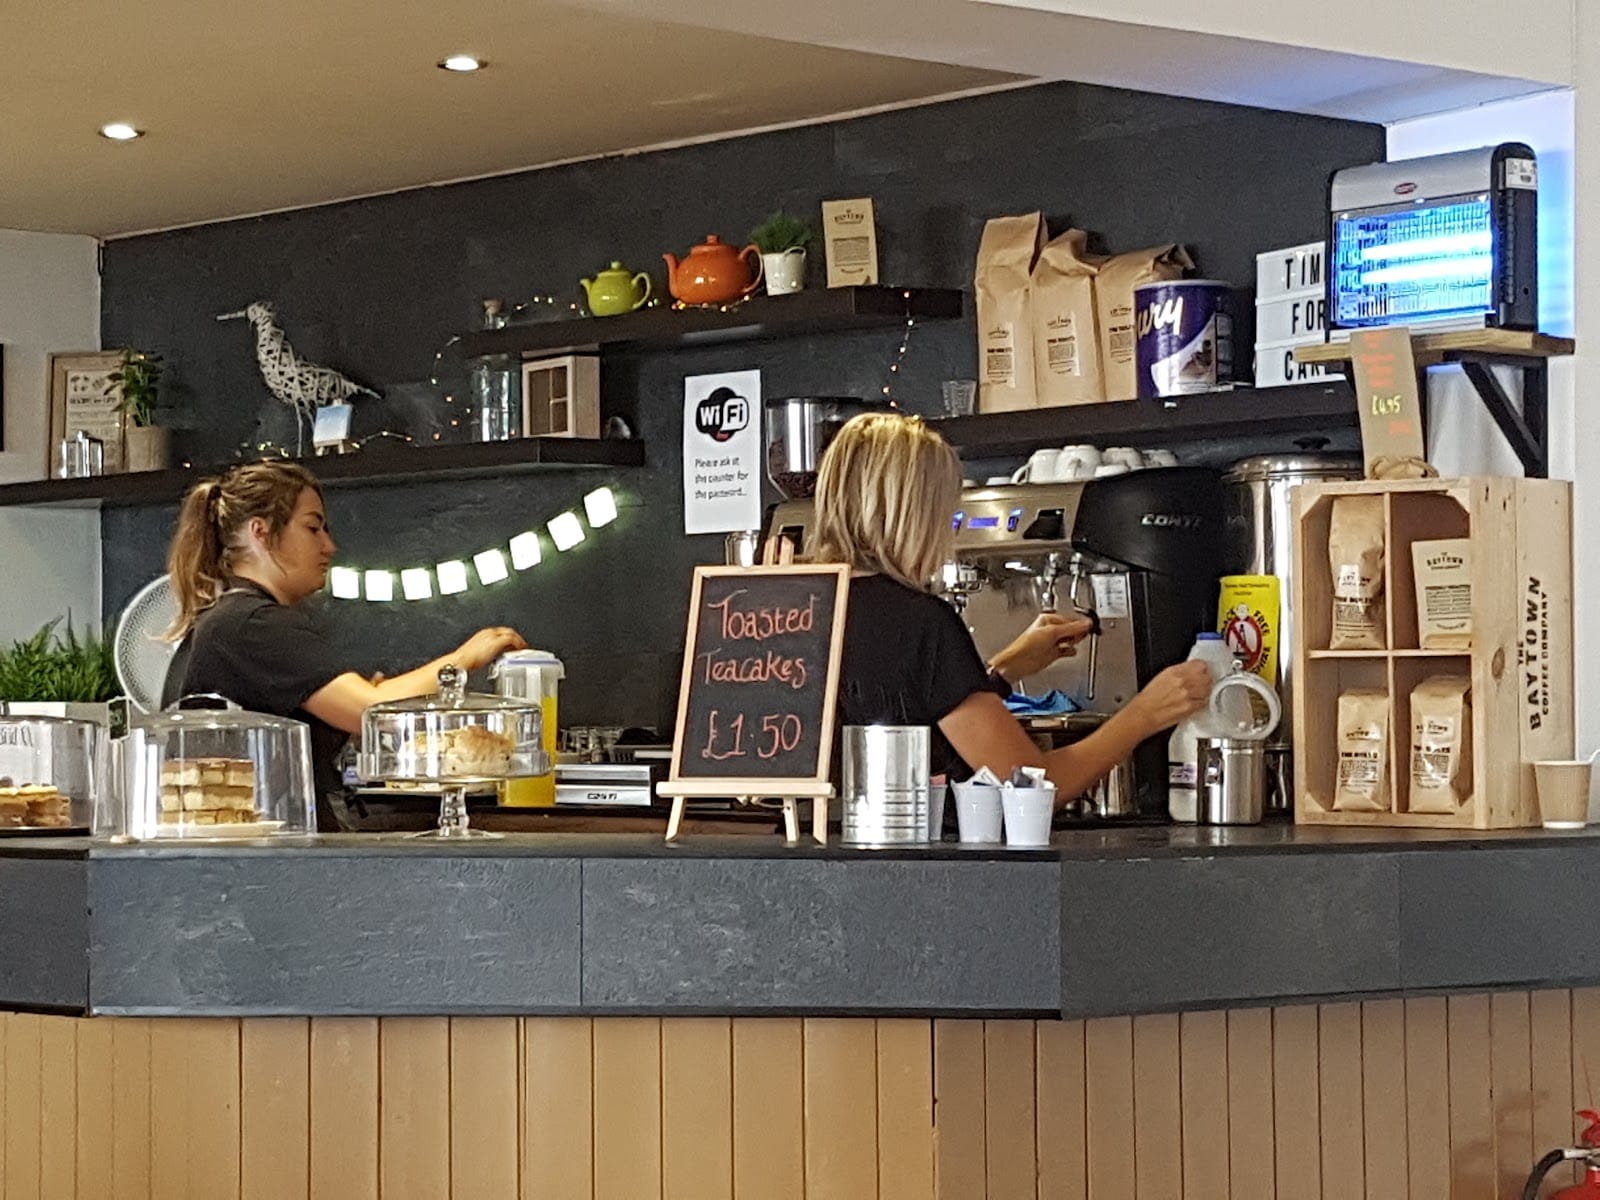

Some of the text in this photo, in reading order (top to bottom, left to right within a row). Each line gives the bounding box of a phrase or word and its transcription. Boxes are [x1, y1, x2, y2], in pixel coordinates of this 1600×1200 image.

[1292, 300, 1326, 335] FOR
[1285, 350, 1327, 381] CA
[707, 588, 821, 641] Toasted
[697, 647, 808, 690] Teacakes
[1525, 576, 1542, 731] BAYTOWN
[1541, 591, 1549, 716] COFFEE COMPANY
